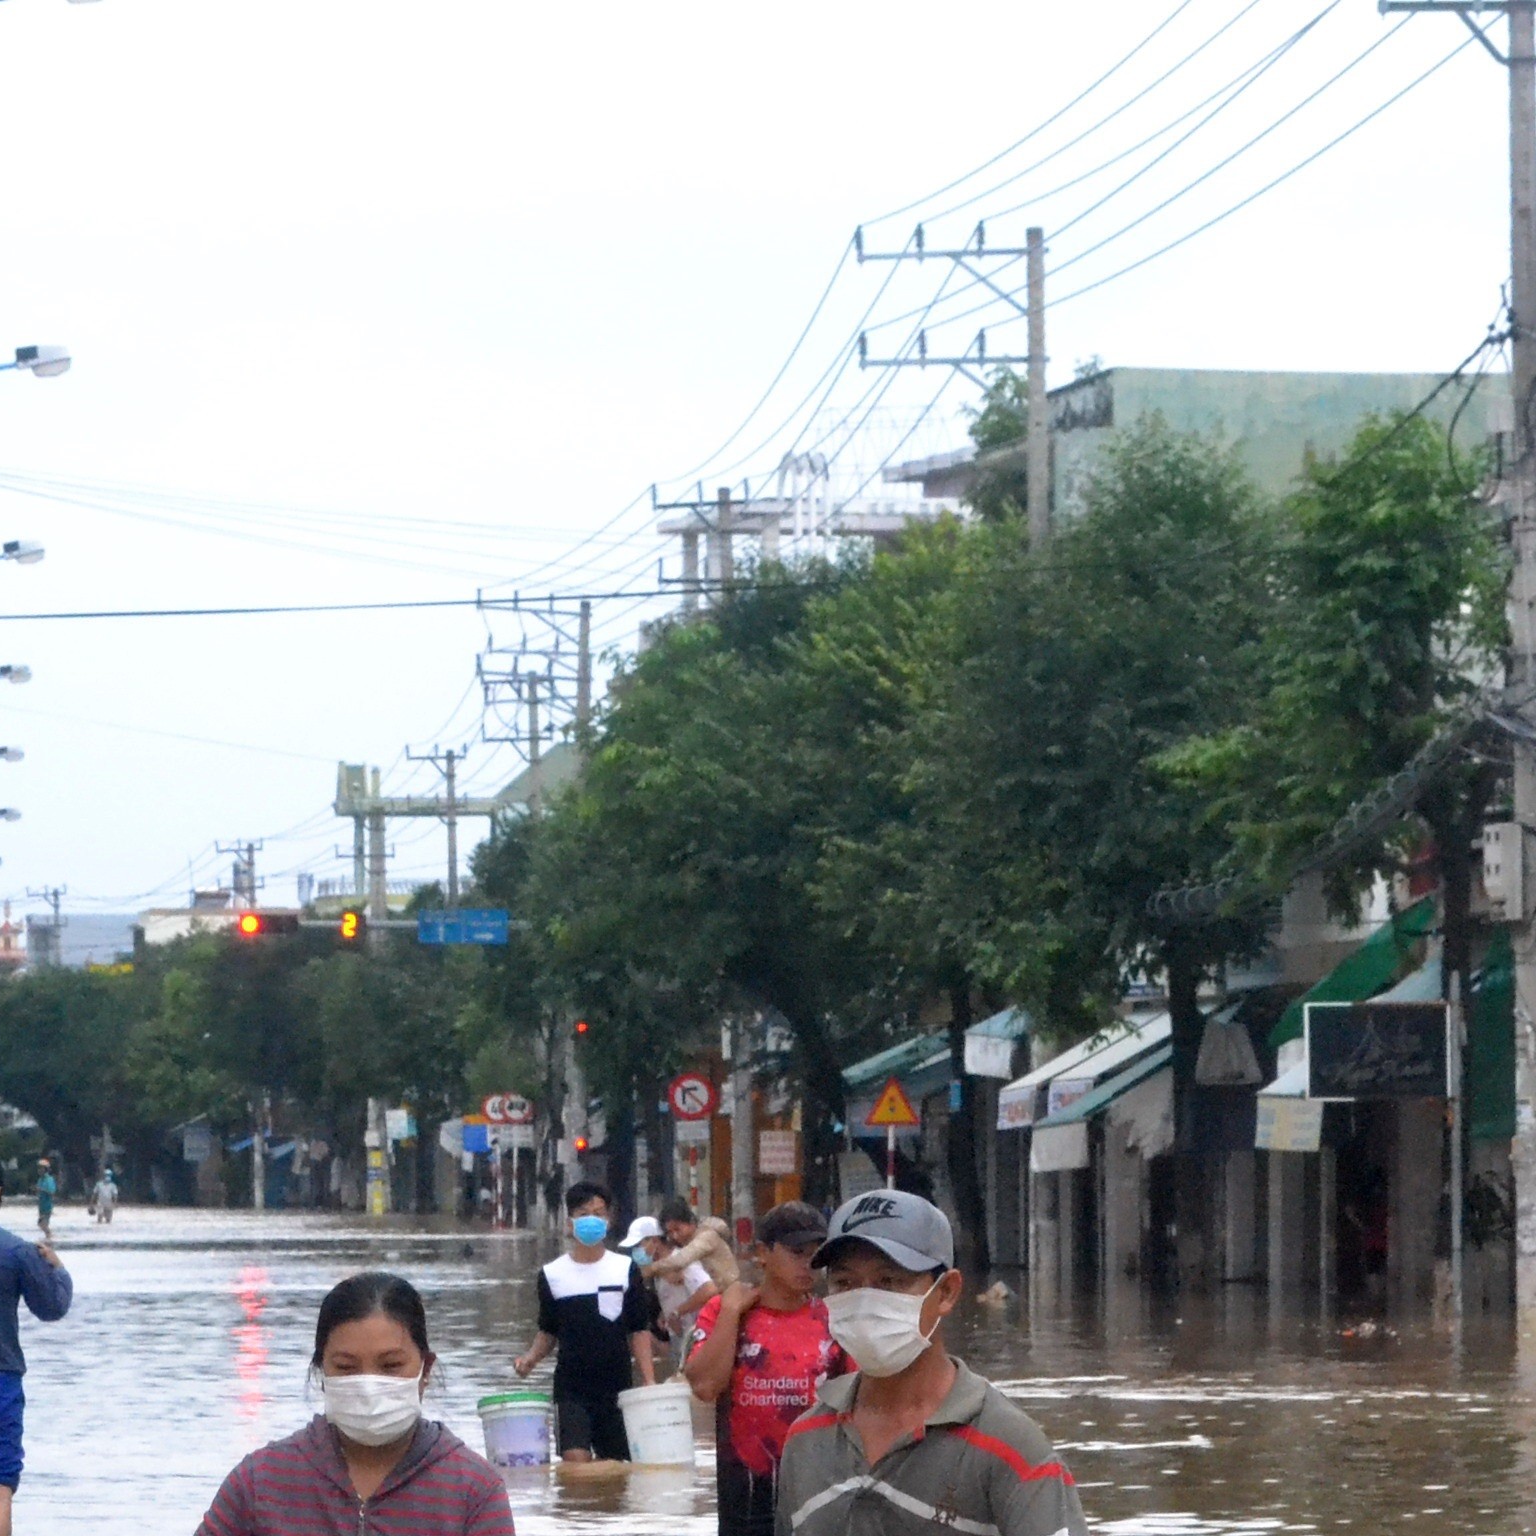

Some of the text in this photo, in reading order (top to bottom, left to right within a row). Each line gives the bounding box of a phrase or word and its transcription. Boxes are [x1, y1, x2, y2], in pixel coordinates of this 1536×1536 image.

[852, 1196, 897, 1216] NIKE
[743, 1376, 809, 1389] Standard
[739, 1392, 809, 1406] Chartered
